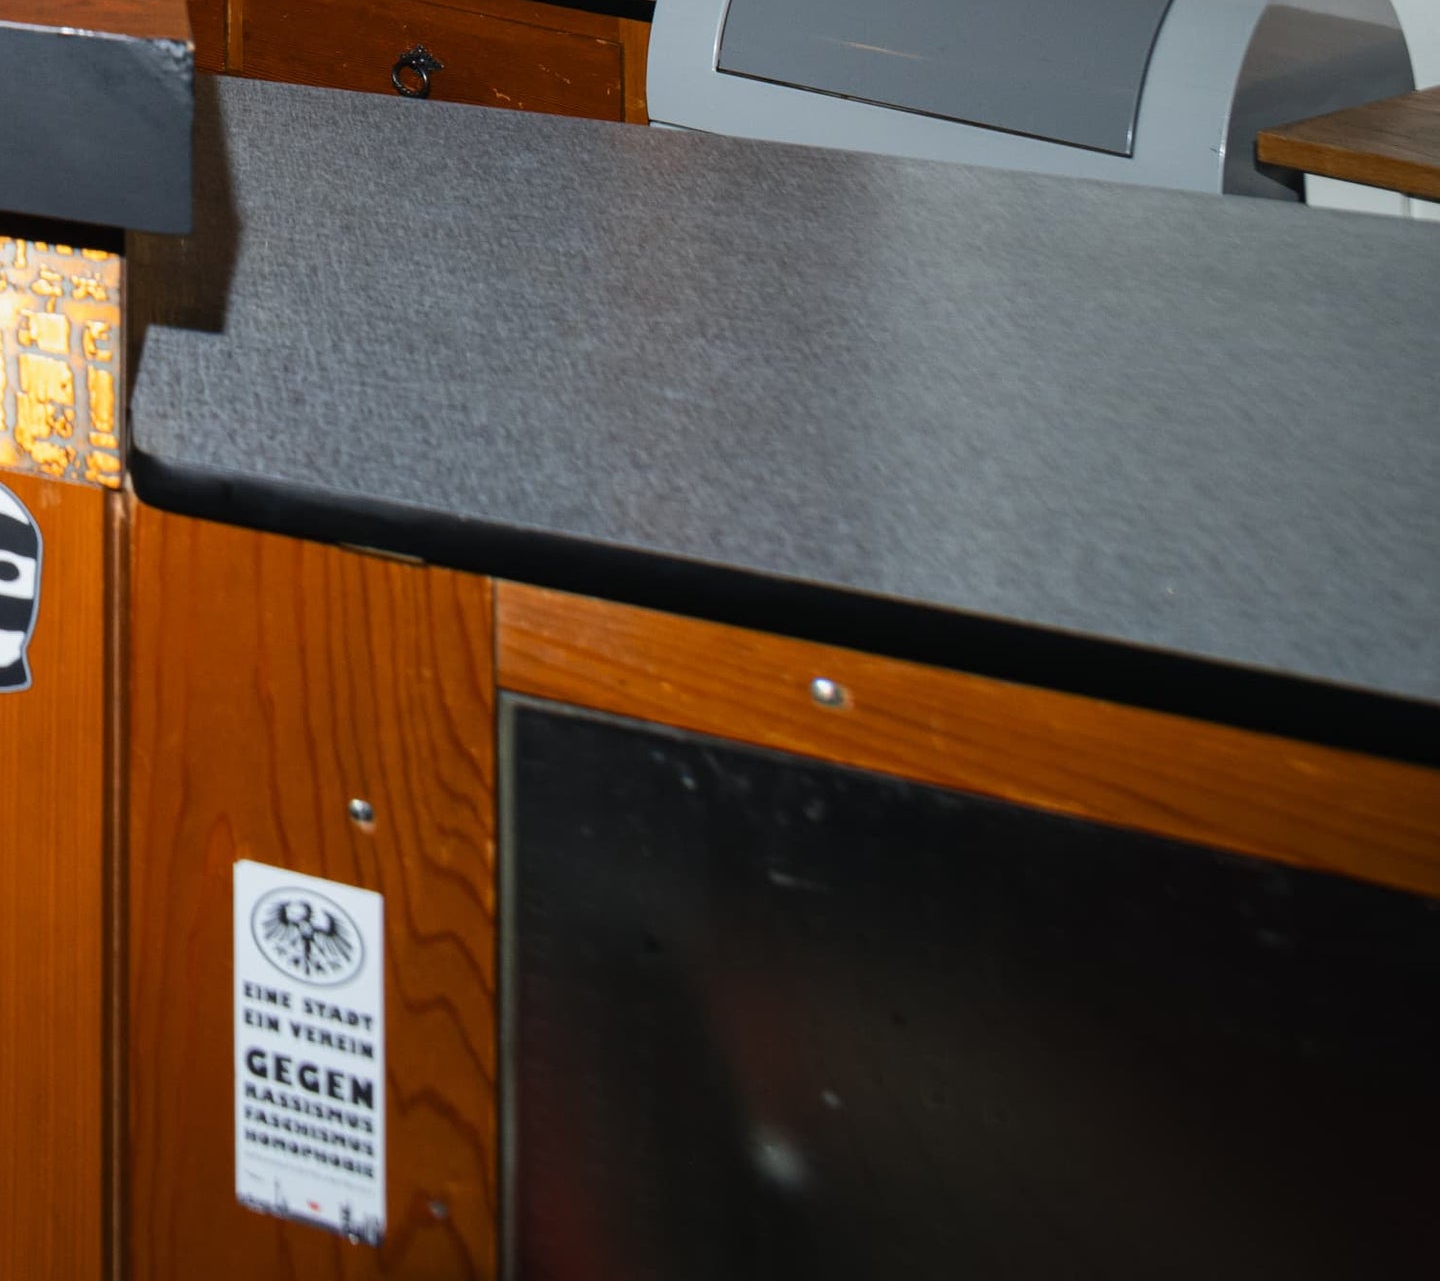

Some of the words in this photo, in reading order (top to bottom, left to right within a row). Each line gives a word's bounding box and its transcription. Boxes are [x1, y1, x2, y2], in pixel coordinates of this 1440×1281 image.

[243, 982, 291, 1009] EINE
[304, 997, 373, 1031] STADT
[243, 1008, 279, 1032] EIN
[290, 1021, 374, 1060] VEREIN
[245, 1047, 374, 1111] GEGEN
[244, 1081, 374, 1134] RASSISMUS
[244, 1106, 374, 1157] FASCHISMUS
[244, 1129, 374, 1179] HOMOPHOBIE
